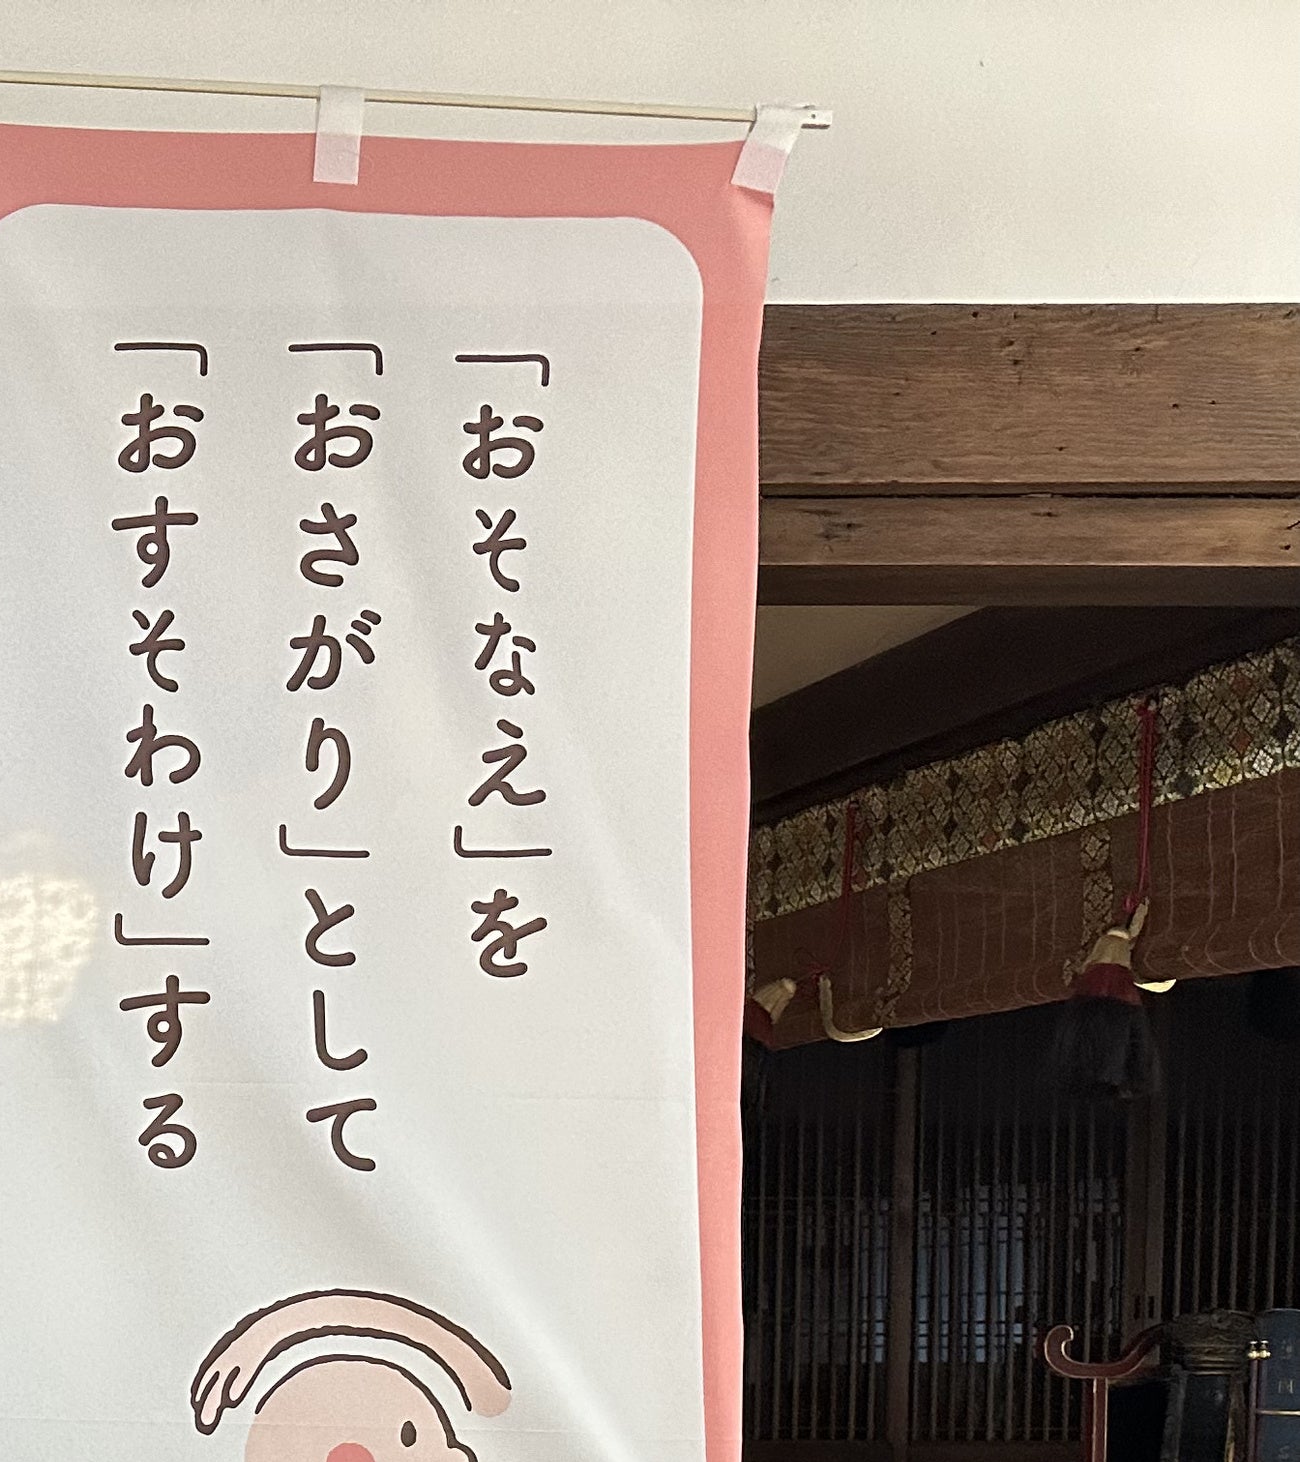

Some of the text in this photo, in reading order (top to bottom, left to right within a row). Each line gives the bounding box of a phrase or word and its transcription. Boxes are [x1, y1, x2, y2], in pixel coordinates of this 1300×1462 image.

[112, 342, 211, 1169] 「おすそわけ」する
[280, 342, 383, 1172] 「おさがり」として
[454, 353, 553, 978] 「おそなえ」を
